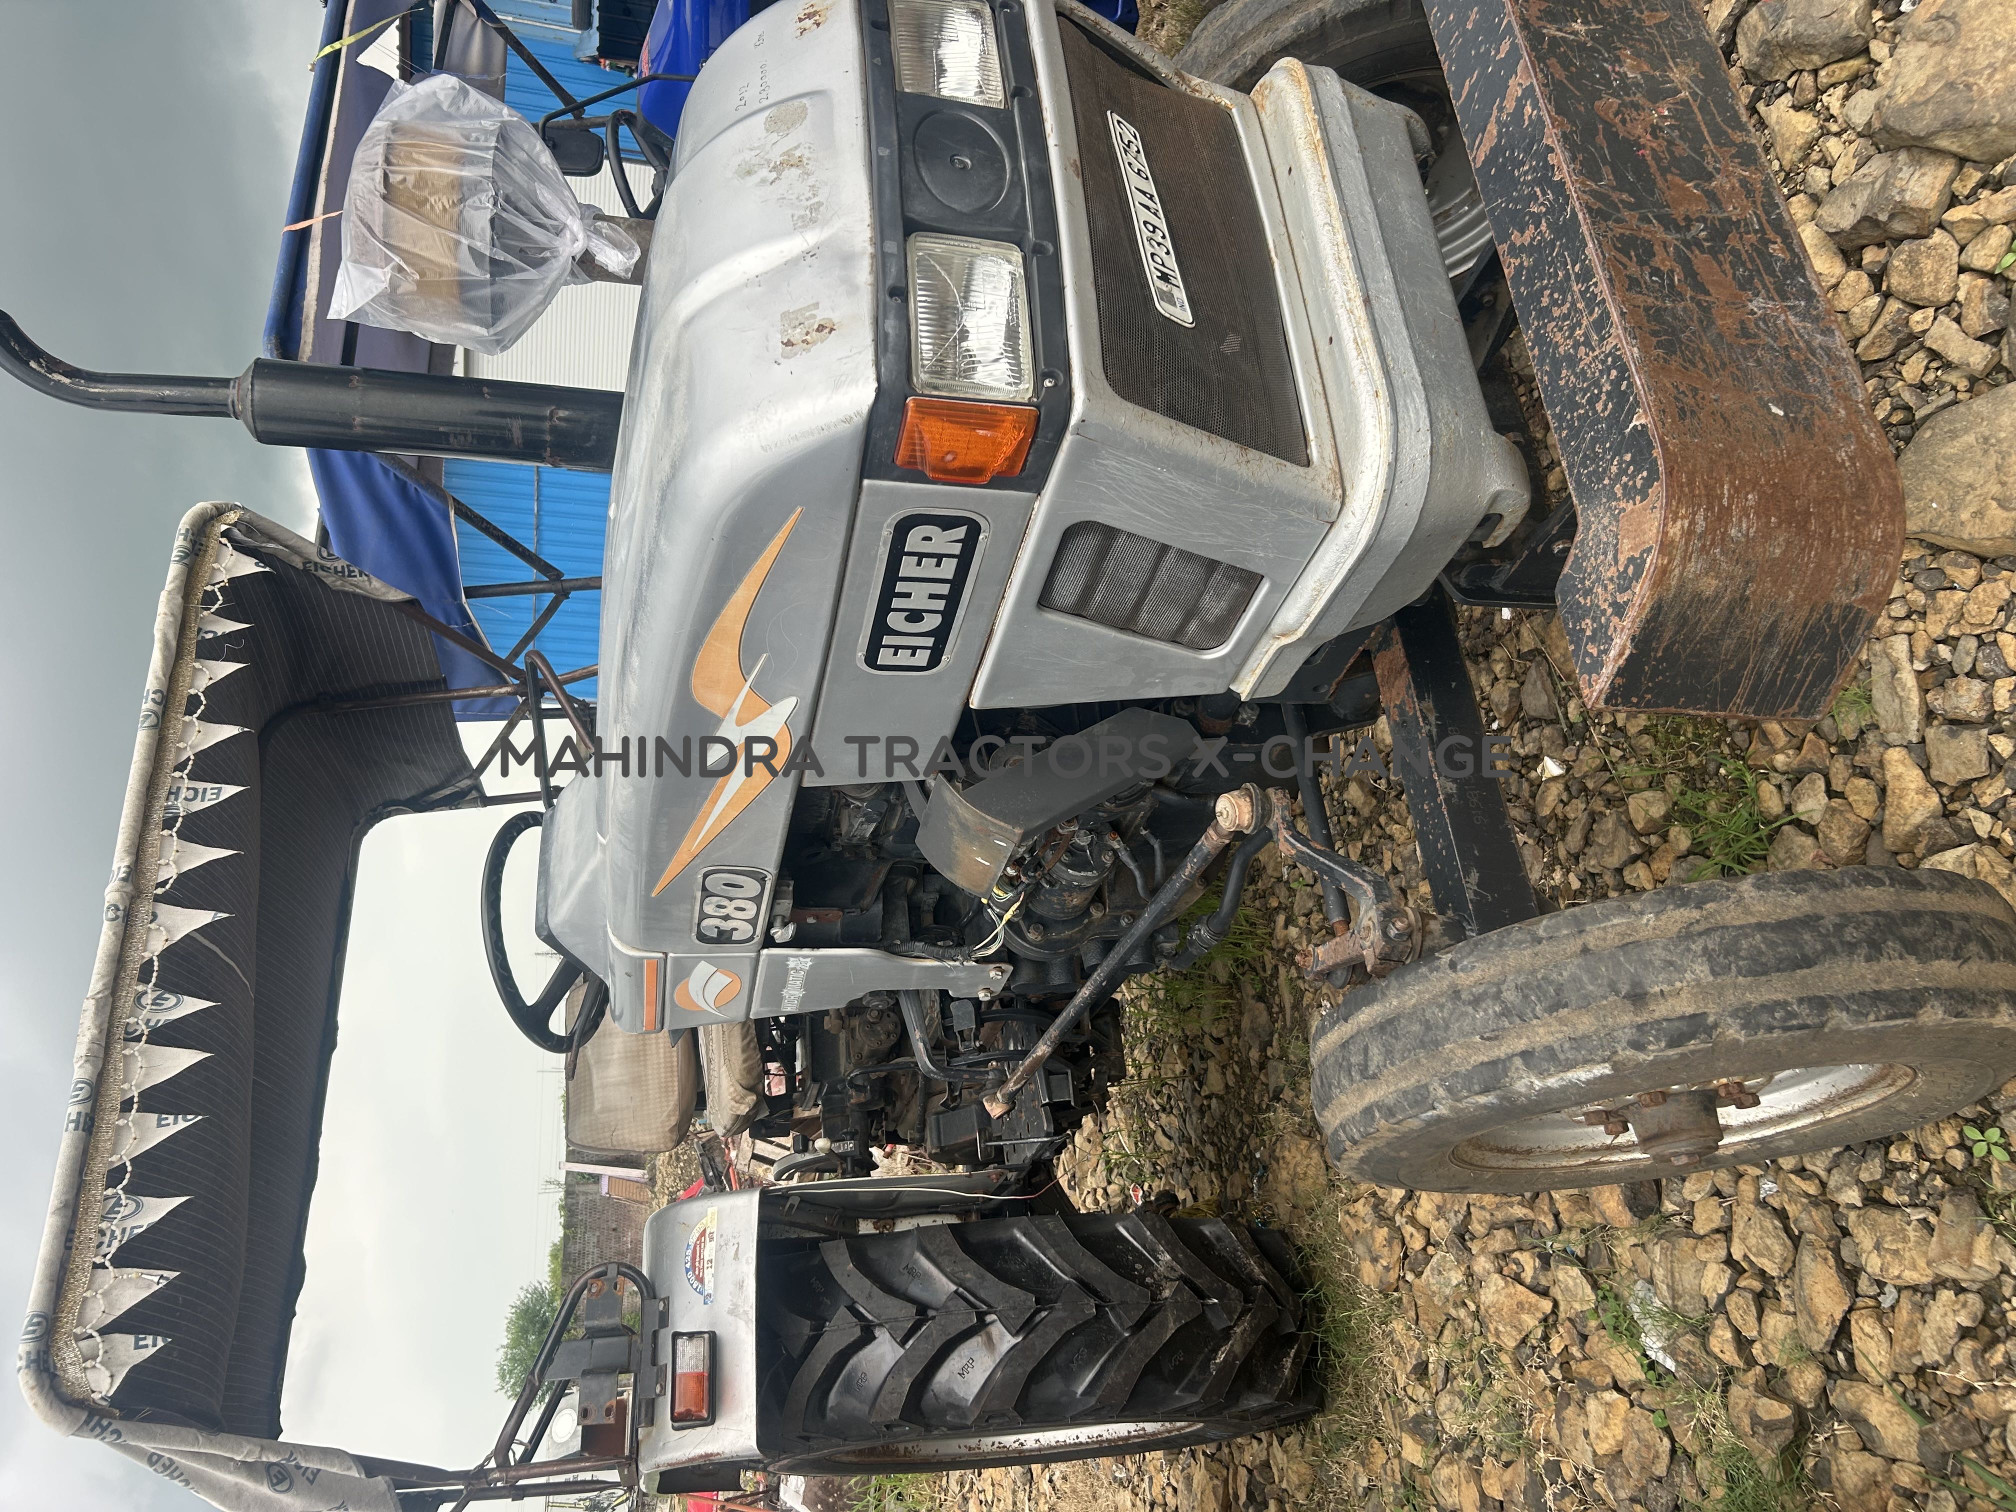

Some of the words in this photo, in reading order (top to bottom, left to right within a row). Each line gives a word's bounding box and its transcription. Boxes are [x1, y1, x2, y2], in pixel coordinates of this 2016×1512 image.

[1116, 119, 1149, 181] 6752
[1133, 185, 1162, 220] AA
[1142, 218, 1181, 290] MP39
[877, 524, 968, 667] EICHER
[700, 873, 762, 941] 380
